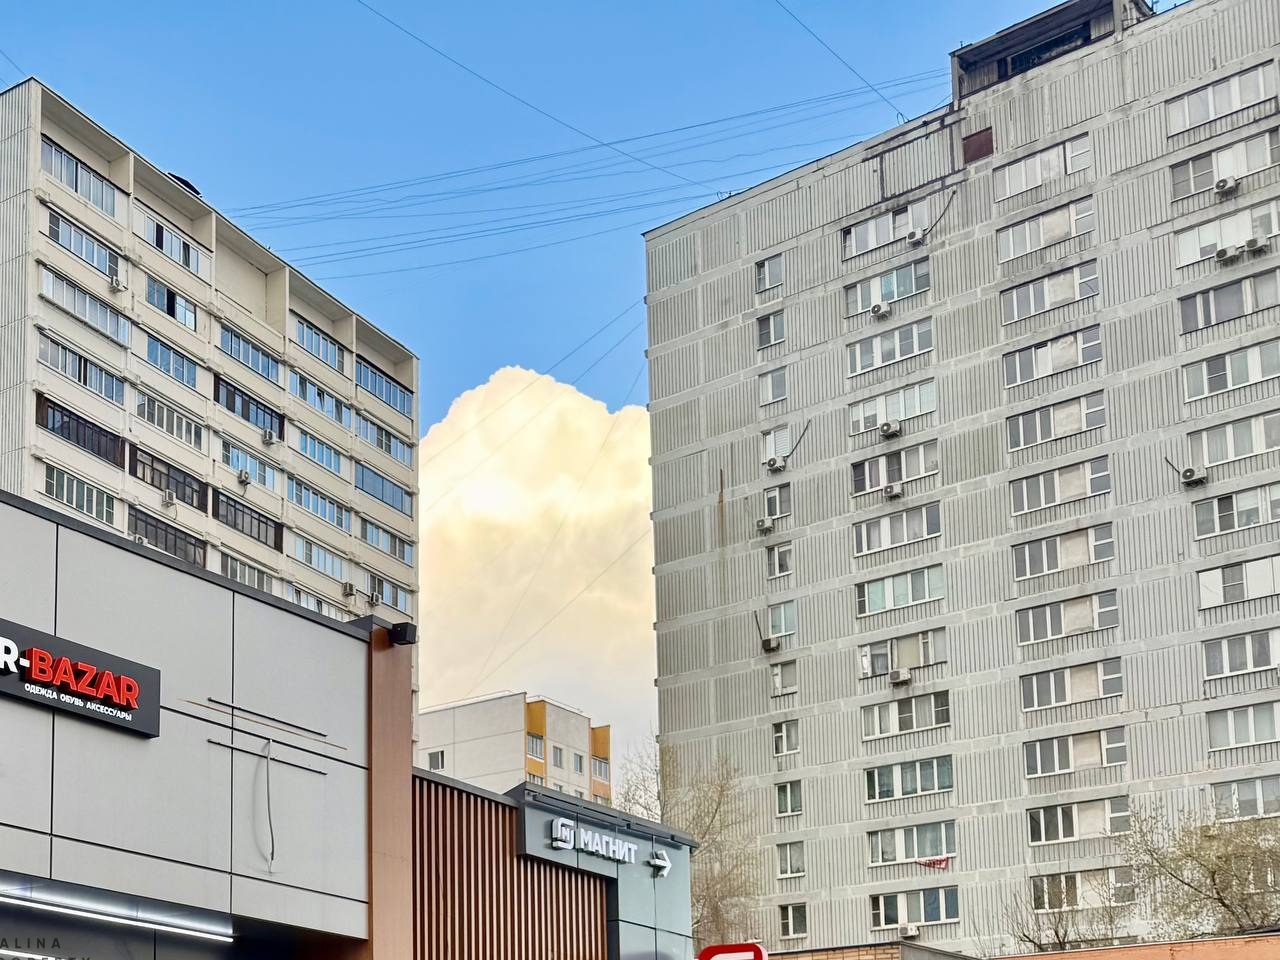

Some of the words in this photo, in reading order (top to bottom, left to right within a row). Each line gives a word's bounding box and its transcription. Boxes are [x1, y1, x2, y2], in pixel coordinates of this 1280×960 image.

[24, 683, 58, 700] ОДЕЖДА
[60, 693, 84, 707] ОБУВЬ
[86, 701, 133, 721] АКСЕССУАРЫ
[580, 828, 638, 864] МАГНИТ
